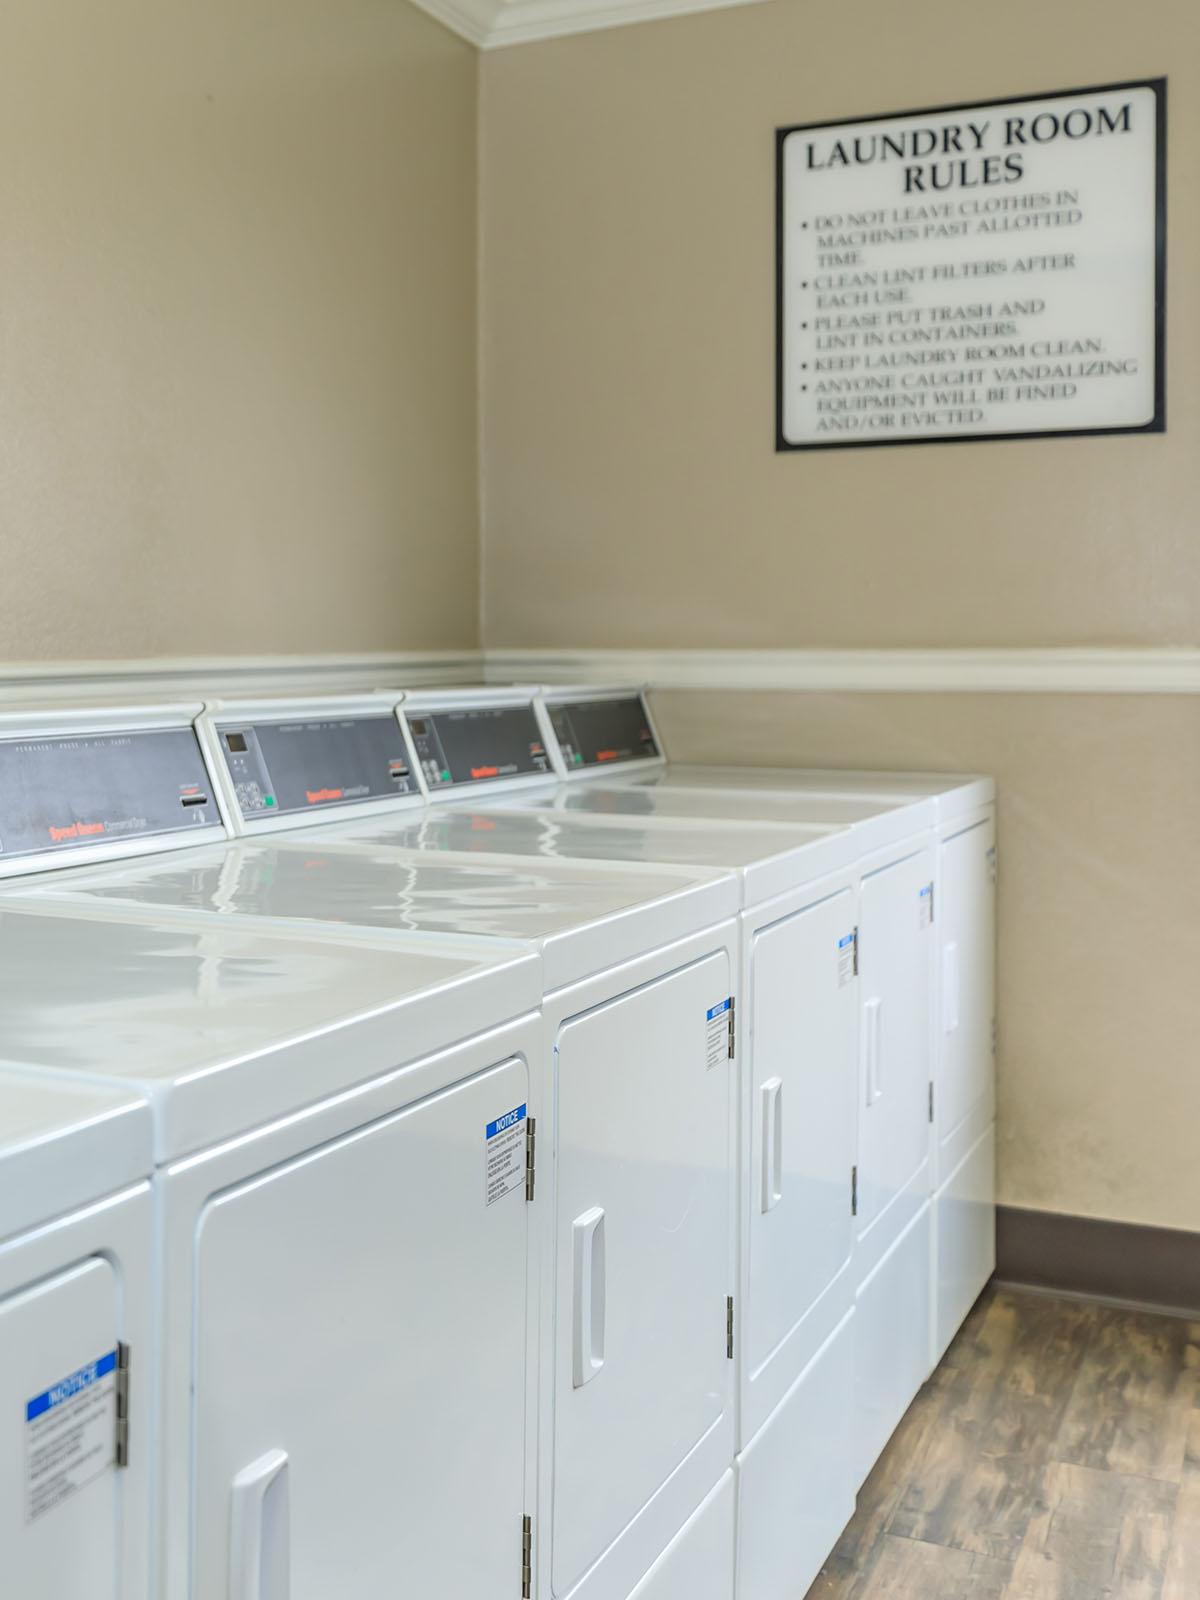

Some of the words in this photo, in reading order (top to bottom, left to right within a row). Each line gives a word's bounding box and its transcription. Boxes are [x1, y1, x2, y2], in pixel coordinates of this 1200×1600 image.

[805, 121, 991, 171] LAUNDRY
[1004, 102, 1133, 147] ROOM
[903, 153, 1025, 194] RULES
[815, 214, 843, 230] DO
[847, 209, 886, 226] NOT
[892, 202, 953, 222] LEAVE
[959, 192, 1051, 215] CLOTHES
[1056, 189, 1079, 206] IN
[816, 225, 920, 248] MACHINES
[923, 220, 969, 238] PAST
[976, 208, 1083, 232] ALLOTTED
[814, 271, 877, 289] CLEAN
[882, 265, 926, 284] LINT
[932, 259, 1008, 280] FILTERS
[1012, 253, 1076, 272] AFTER
[814, 312, 881, 331] PLEASE
[886, 309, 922, 325] PUT
[928, 303, 993, 322] TRASH
[998, 298, 1046, 317] AND
[816, 291, 869, 309] EACH
[815, 354, 860, 371] KEEP
[865, 348, 958, 369] LAUNDRY
[964, 342, 1026, 361] ROOM
[816, 331, 859, 350] LINT
[864, 331, 884, 347] IN
[815, 374, 895, 394] ANYONE
[901, 368, 985, 388] CAUGHT
[993, 358, 1138, 382] VANDALIZING
[816, 391, 927, 414] EQUIPMENT
[933, 388, 977, 406] WILL
[986, 386, 1009, 404] BE
[1015, 382, 1077, 401] FINED
[815, 412, 896, 432] AND/OR
[495, 1109, 519, 1133] NOTICE
[49, 1362, 97, 1406] NOTICE
